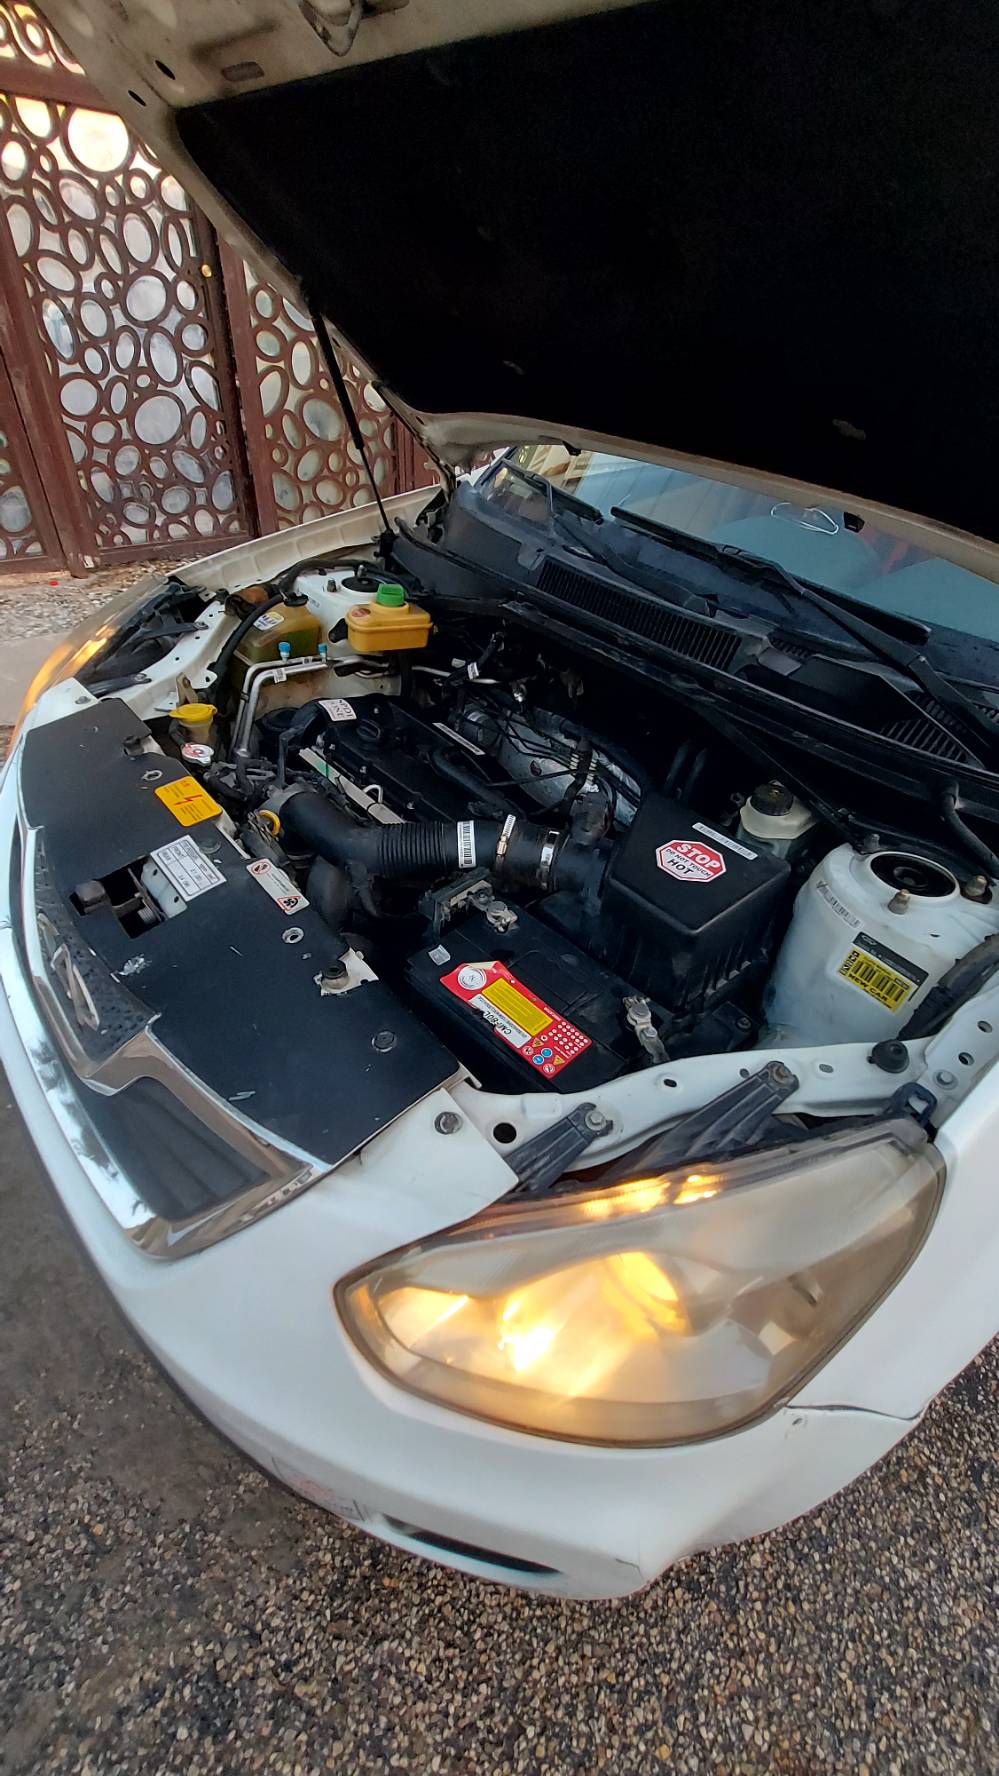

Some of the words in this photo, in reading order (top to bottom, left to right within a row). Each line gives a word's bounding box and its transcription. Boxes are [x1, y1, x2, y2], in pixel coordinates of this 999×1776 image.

[667, 858, 694, 874] HOT
[674, 854, 688, 863] NOT
[690, 862, 711, 877] TOUCH
[676, 843, 721, 868] STOP
